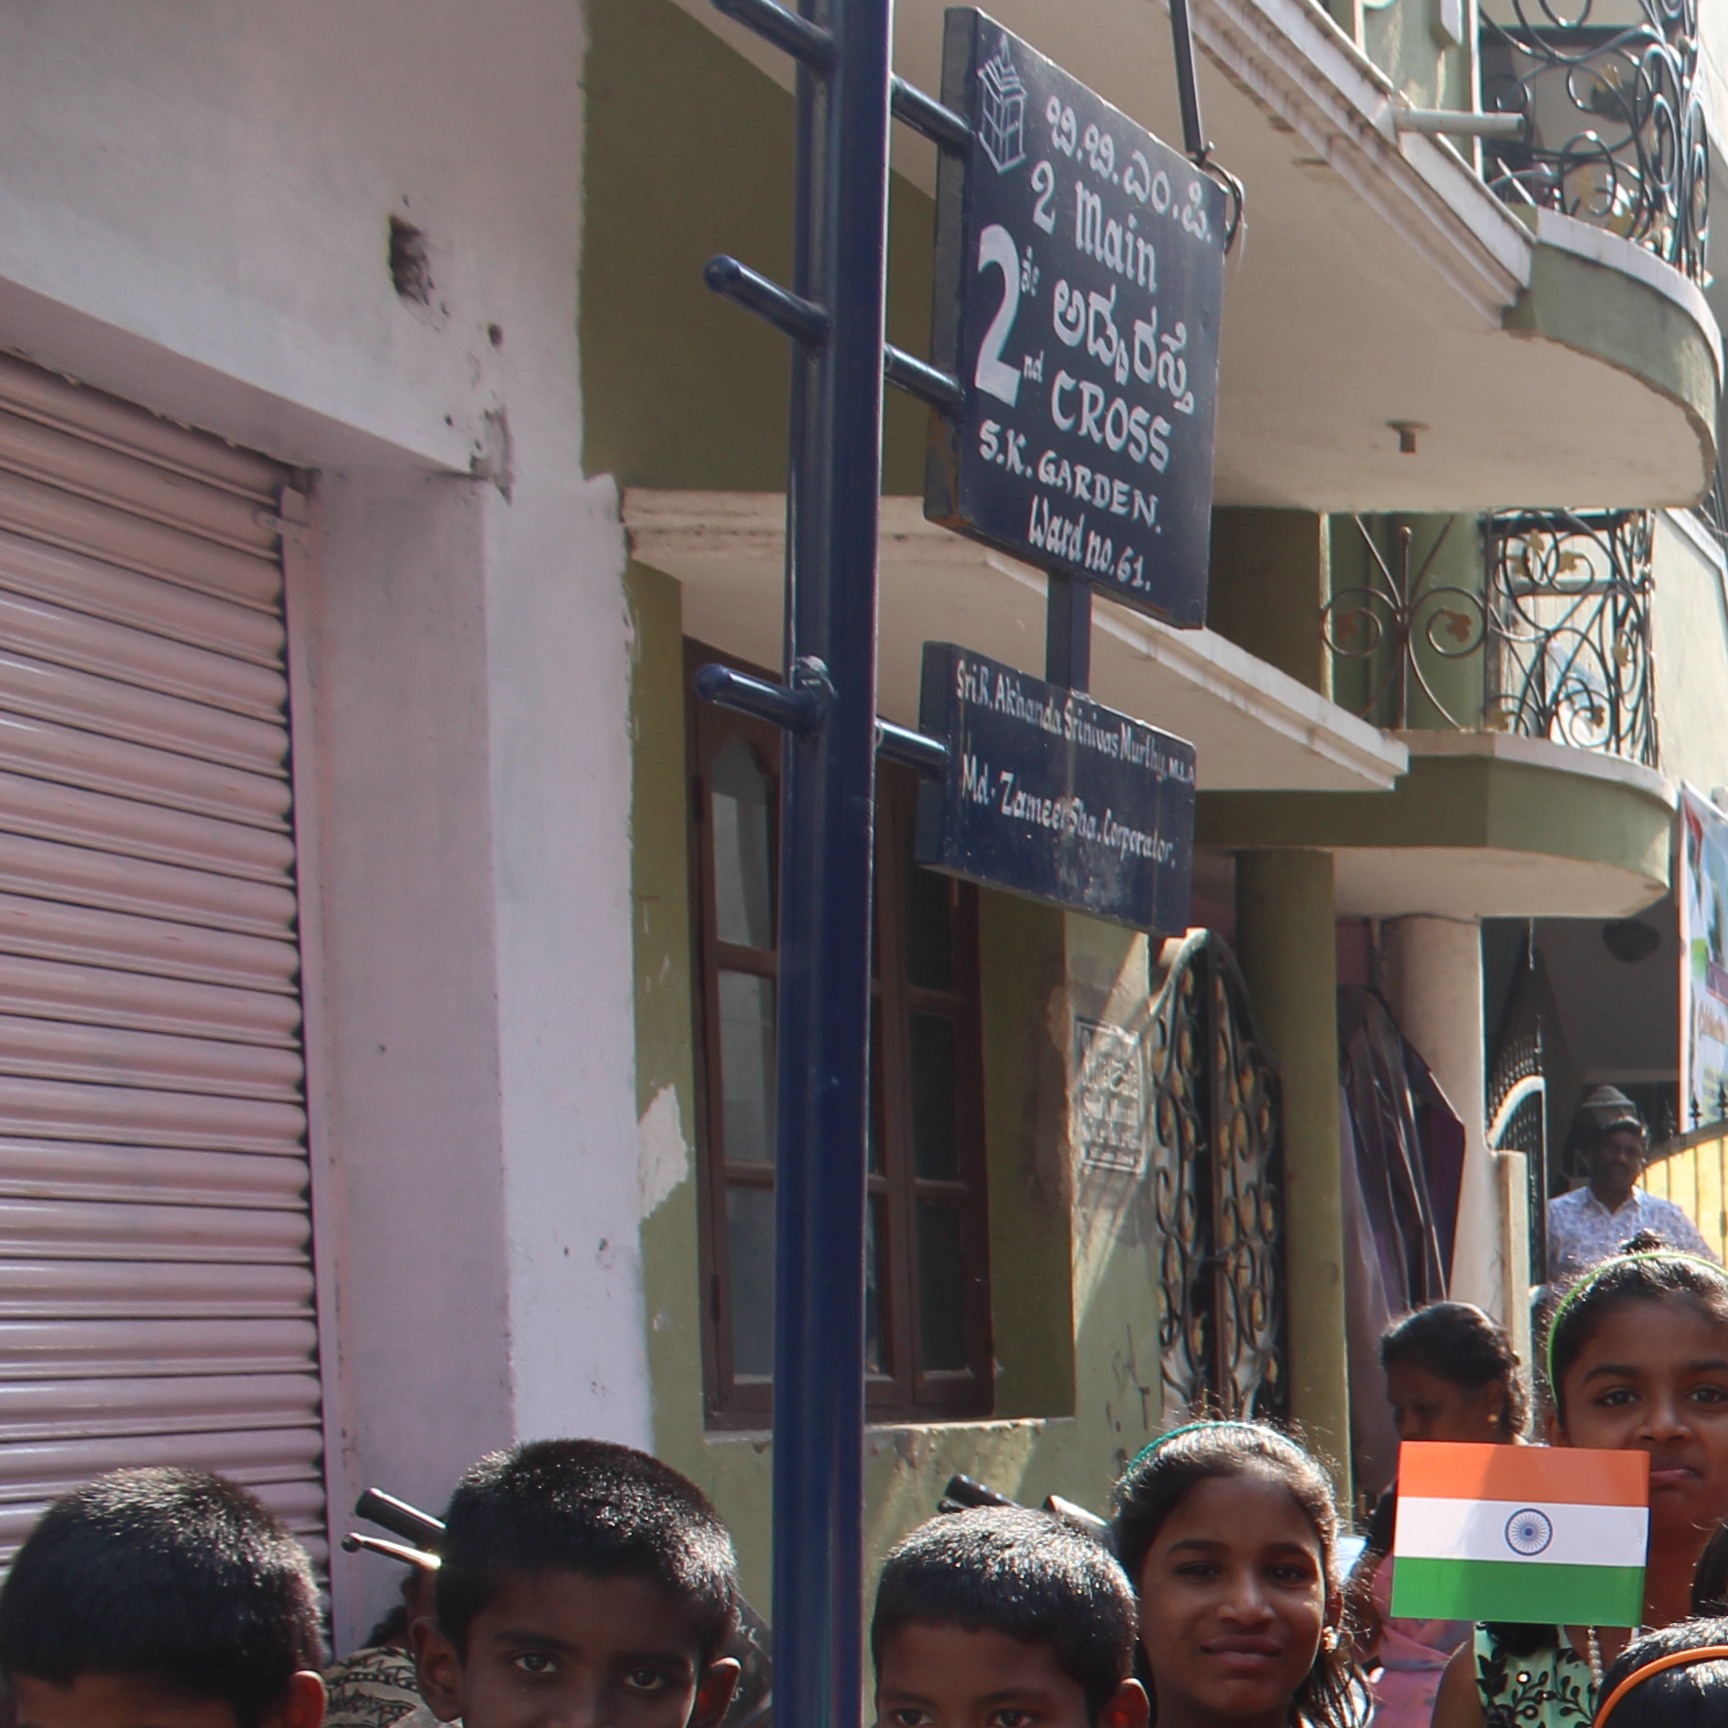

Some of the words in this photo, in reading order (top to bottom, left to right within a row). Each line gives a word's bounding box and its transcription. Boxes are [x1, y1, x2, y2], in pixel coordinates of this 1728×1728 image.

[1030, 160, 1056, 235] 2
[1074, 180, 1158, 293] Main
[1051, 369, 1173, 474] CROSS
[1028, 495, 1085, 562] Ward
[995, 672, 1062, 736] Akhanda
